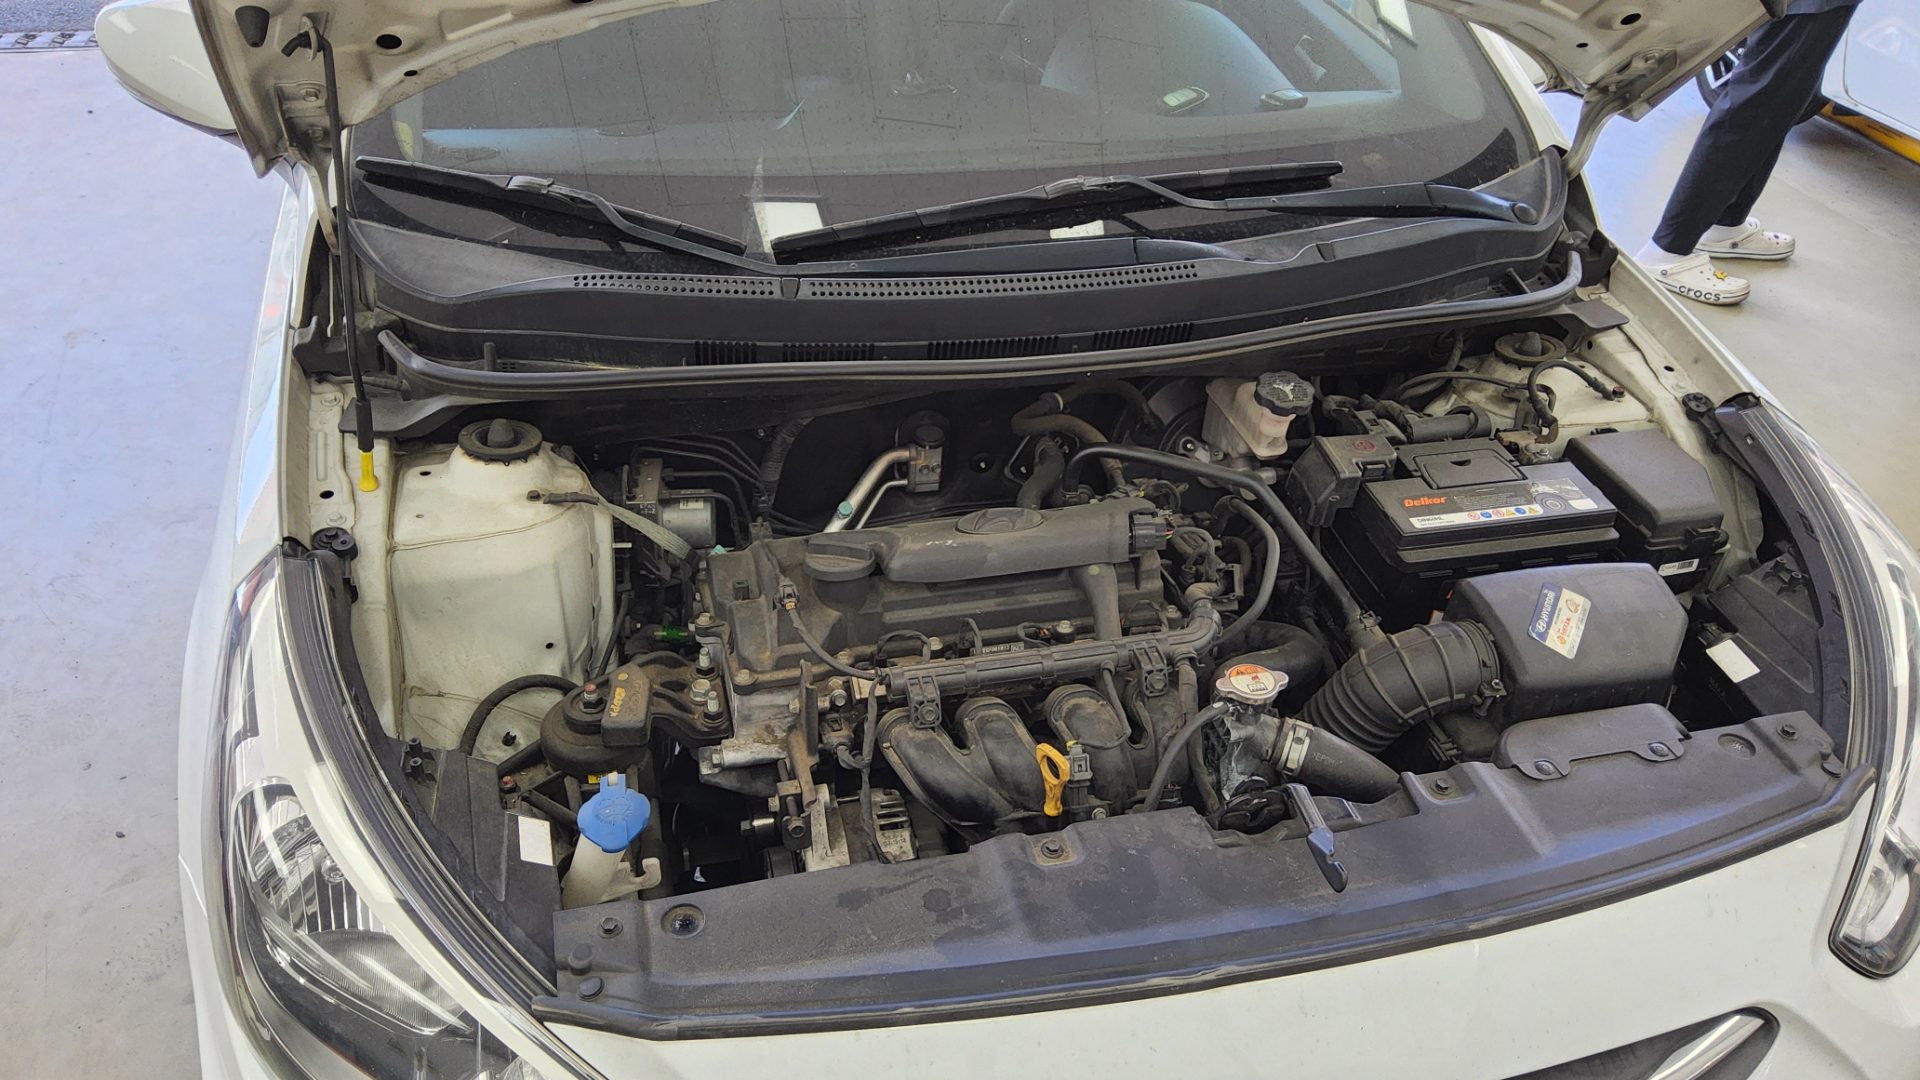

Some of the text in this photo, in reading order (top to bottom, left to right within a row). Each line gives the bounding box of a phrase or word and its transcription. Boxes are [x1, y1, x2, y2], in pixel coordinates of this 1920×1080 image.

[1678, 285, 1721, 301] crocs
[1403, 495, 1447, 508] Delkor
[1541, 591, 1556, 621] HYUNDAI
